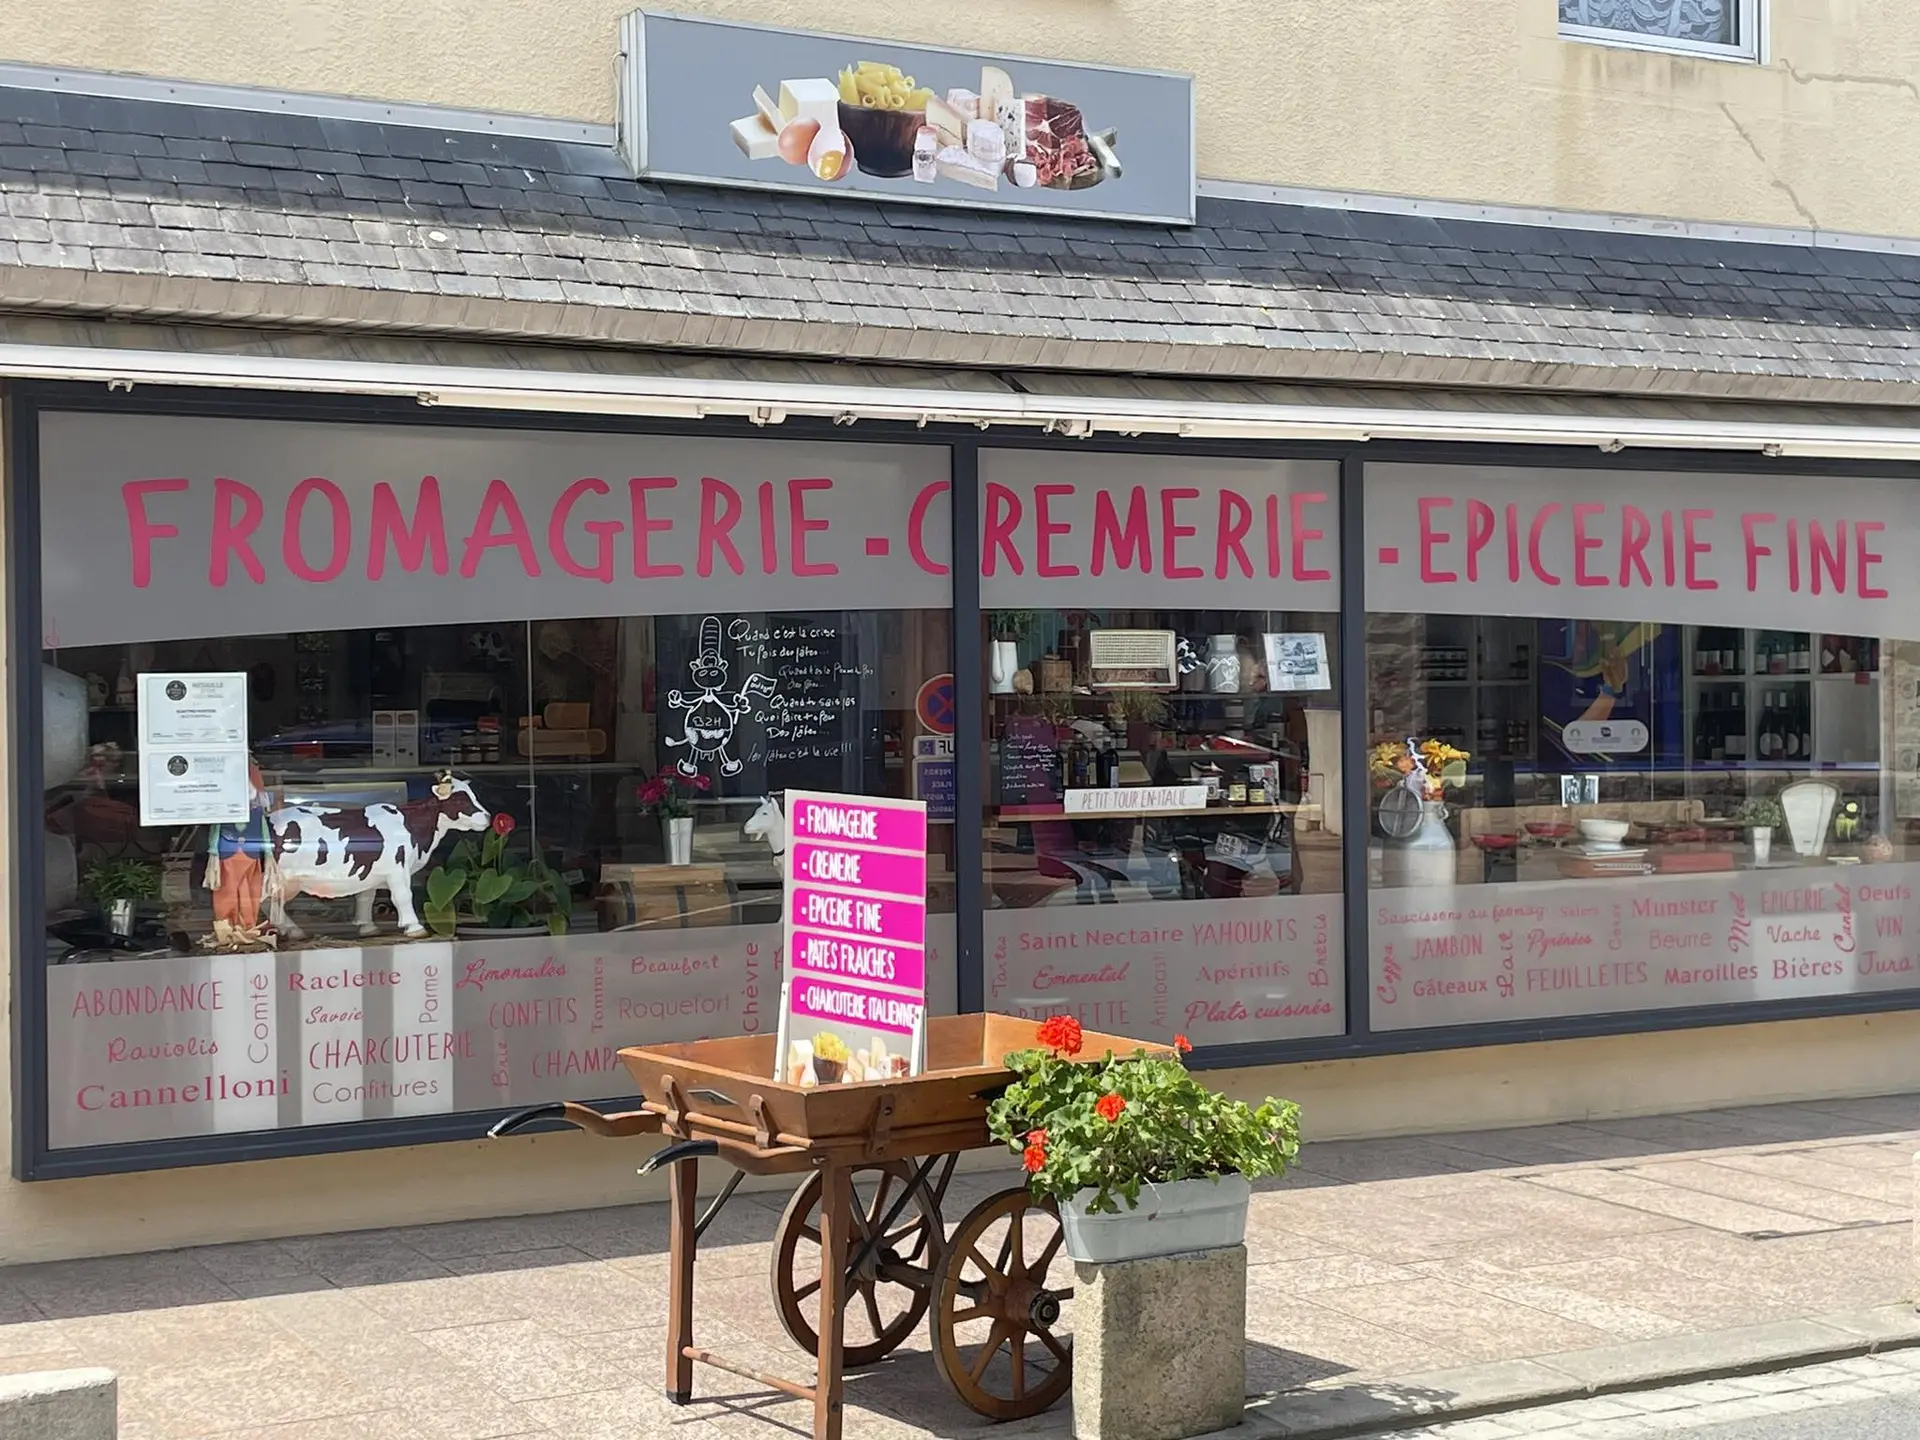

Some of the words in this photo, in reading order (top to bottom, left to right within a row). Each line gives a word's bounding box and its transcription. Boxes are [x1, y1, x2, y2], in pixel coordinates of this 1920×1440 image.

[121, 475, 839, 588] FROMAGERIE
[908, 480, 1331, 581] CREMERIE
[1418, 497, 1719, 591] EPICERIE
[1741, 513, 1889, 599] FINE
[728, 618, 770, 642] Quand
[770, 694, 804, 709] Quand
[1081, 791, 1108, 810] PETIT
[1114, 791, 1137, 809] TOUR
[807, 805, 878, 840] FROMAGERIE
[809, 850, 862, 883] CREMERIE
[1760, 887, 1828, 914] EPICERIE
[1858, 884, 1911, 902] Oeufs
[808, 894, 853, 928] EPICERIE
[856, 901, 883, 933] FINE
[1377, 907, 1463, 926] Saucissons
[1468, 908, 1488, 918] au
[1632, 897, 1718, 918] Munster
[1019, 931, 1078, 951] Saint
[1086, 927, 1184, 948] Nectaire
[1192, 918, 1299, 947] YAHOURTS
[1766, 925, 1821, 944] Vache
[1875, 915, 1904, 937] VIN
[1411, 932, 1482, 961] JAMBON
[1650, 930, 1712, 950] Beurre
[631, 955, 720, 976] Beaufort
[807, 938, 837, 970] PATES
[841, 942, 895, 980] FRAICHES
[1772, 956, 1843, 980] Bières
[288, 969, 402, 991] Raclette
[741, 942, 760, 1033] Chèvre
[1032, 961, 1132, 990] Emmental
[1413, 978, 1487, 998] Gâteaux
[1526, 961, 1649, 992] FEUILLETES
[1664, 963, 1758, 986] Maroilles
[72, 981, 224, 1018] ABONDANCE
[419, 964, 439, 1024] Parme
[618, 994, 730, 1021] Roquefort
[807, 986, 867, 1019] CHARCUTERIE
[247, 973, 269, 1064] Comté
[306, 1005, 364, 1024] Savoie
[489, 997, 578, 1030] CONFITS
[1184, 1000, 1248, 1030] Plats
[108, 1036, 219, 1063] Raviolis
[309, 1030, 478, 1070] CHARCUTERIE
[77, 1069, 292, 1111] Cannelloni
[313, 1079, 439, 1104] Confitures
